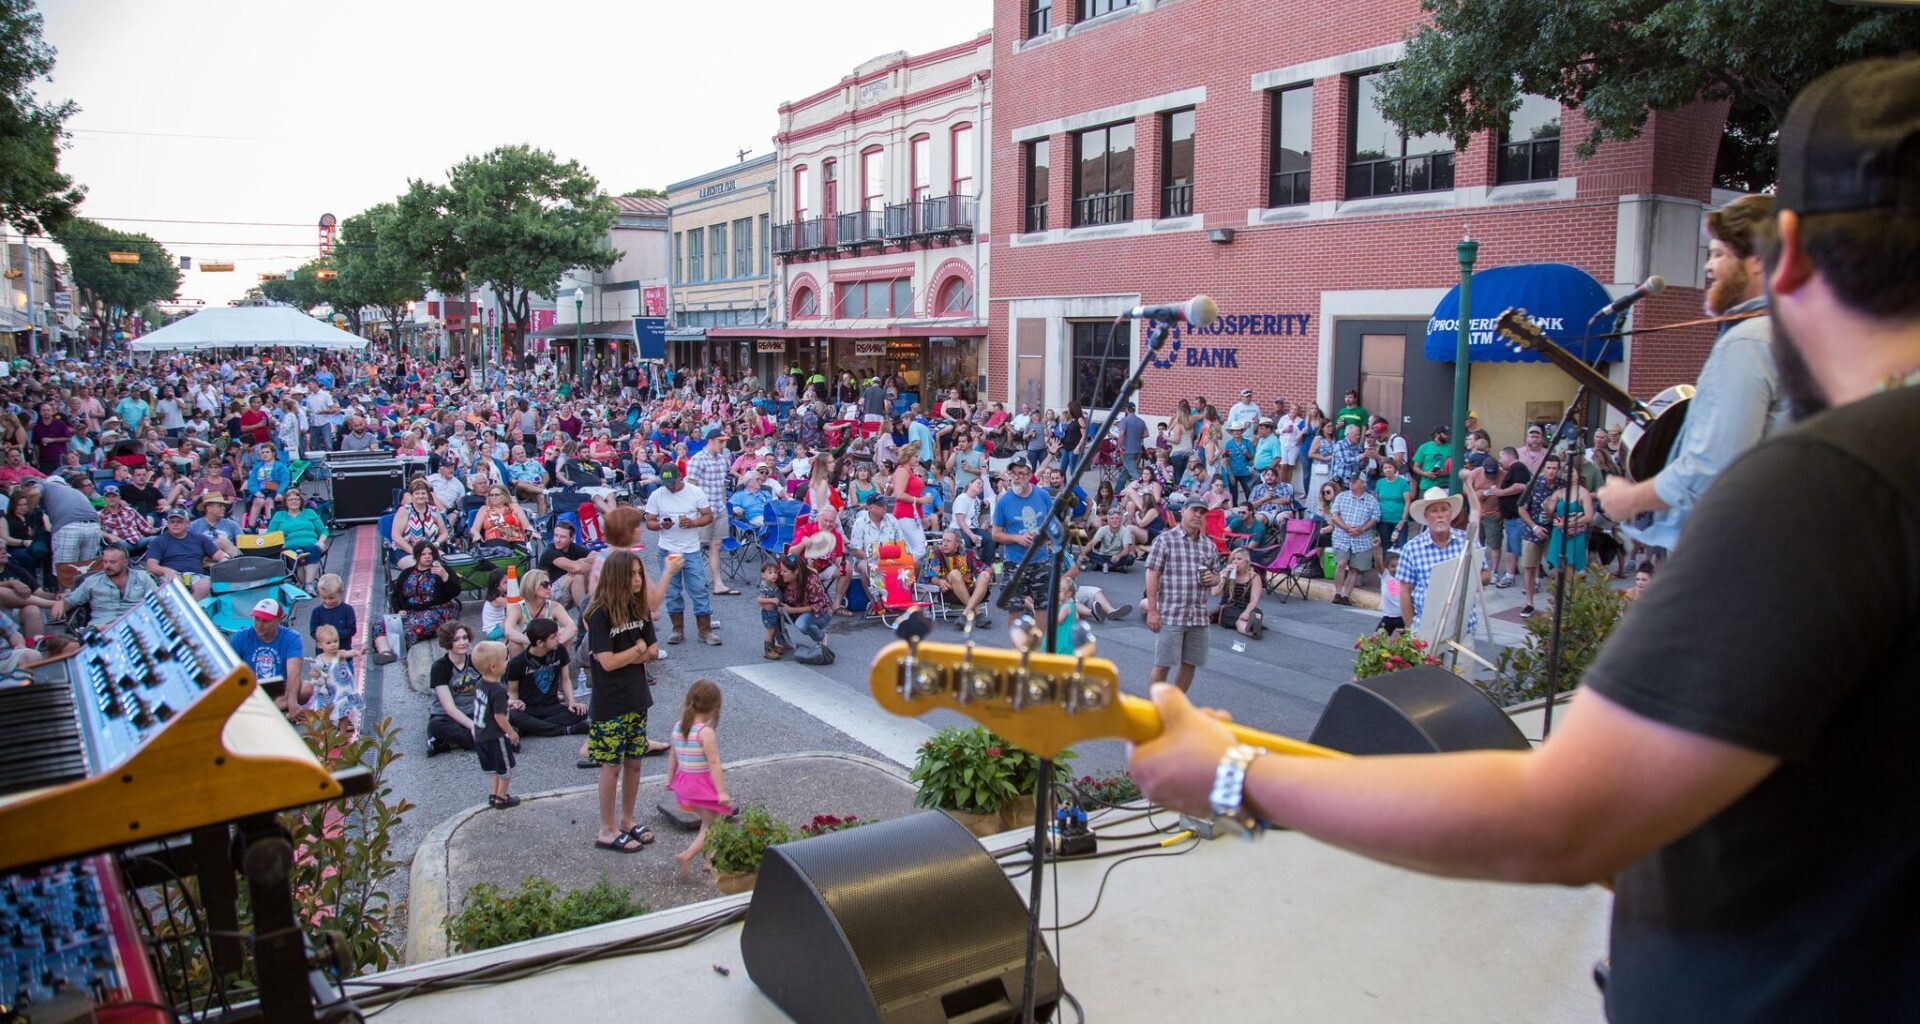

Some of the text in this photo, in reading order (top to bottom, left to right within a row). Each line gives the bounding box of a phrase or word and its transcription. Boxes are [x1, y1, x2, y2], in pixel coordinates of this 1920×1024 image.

[1433, 318, 1499, 331] PROSERI
[856, 343, 884, 353] RE/MAX
[1186, 347, 1239, 368] BANK
